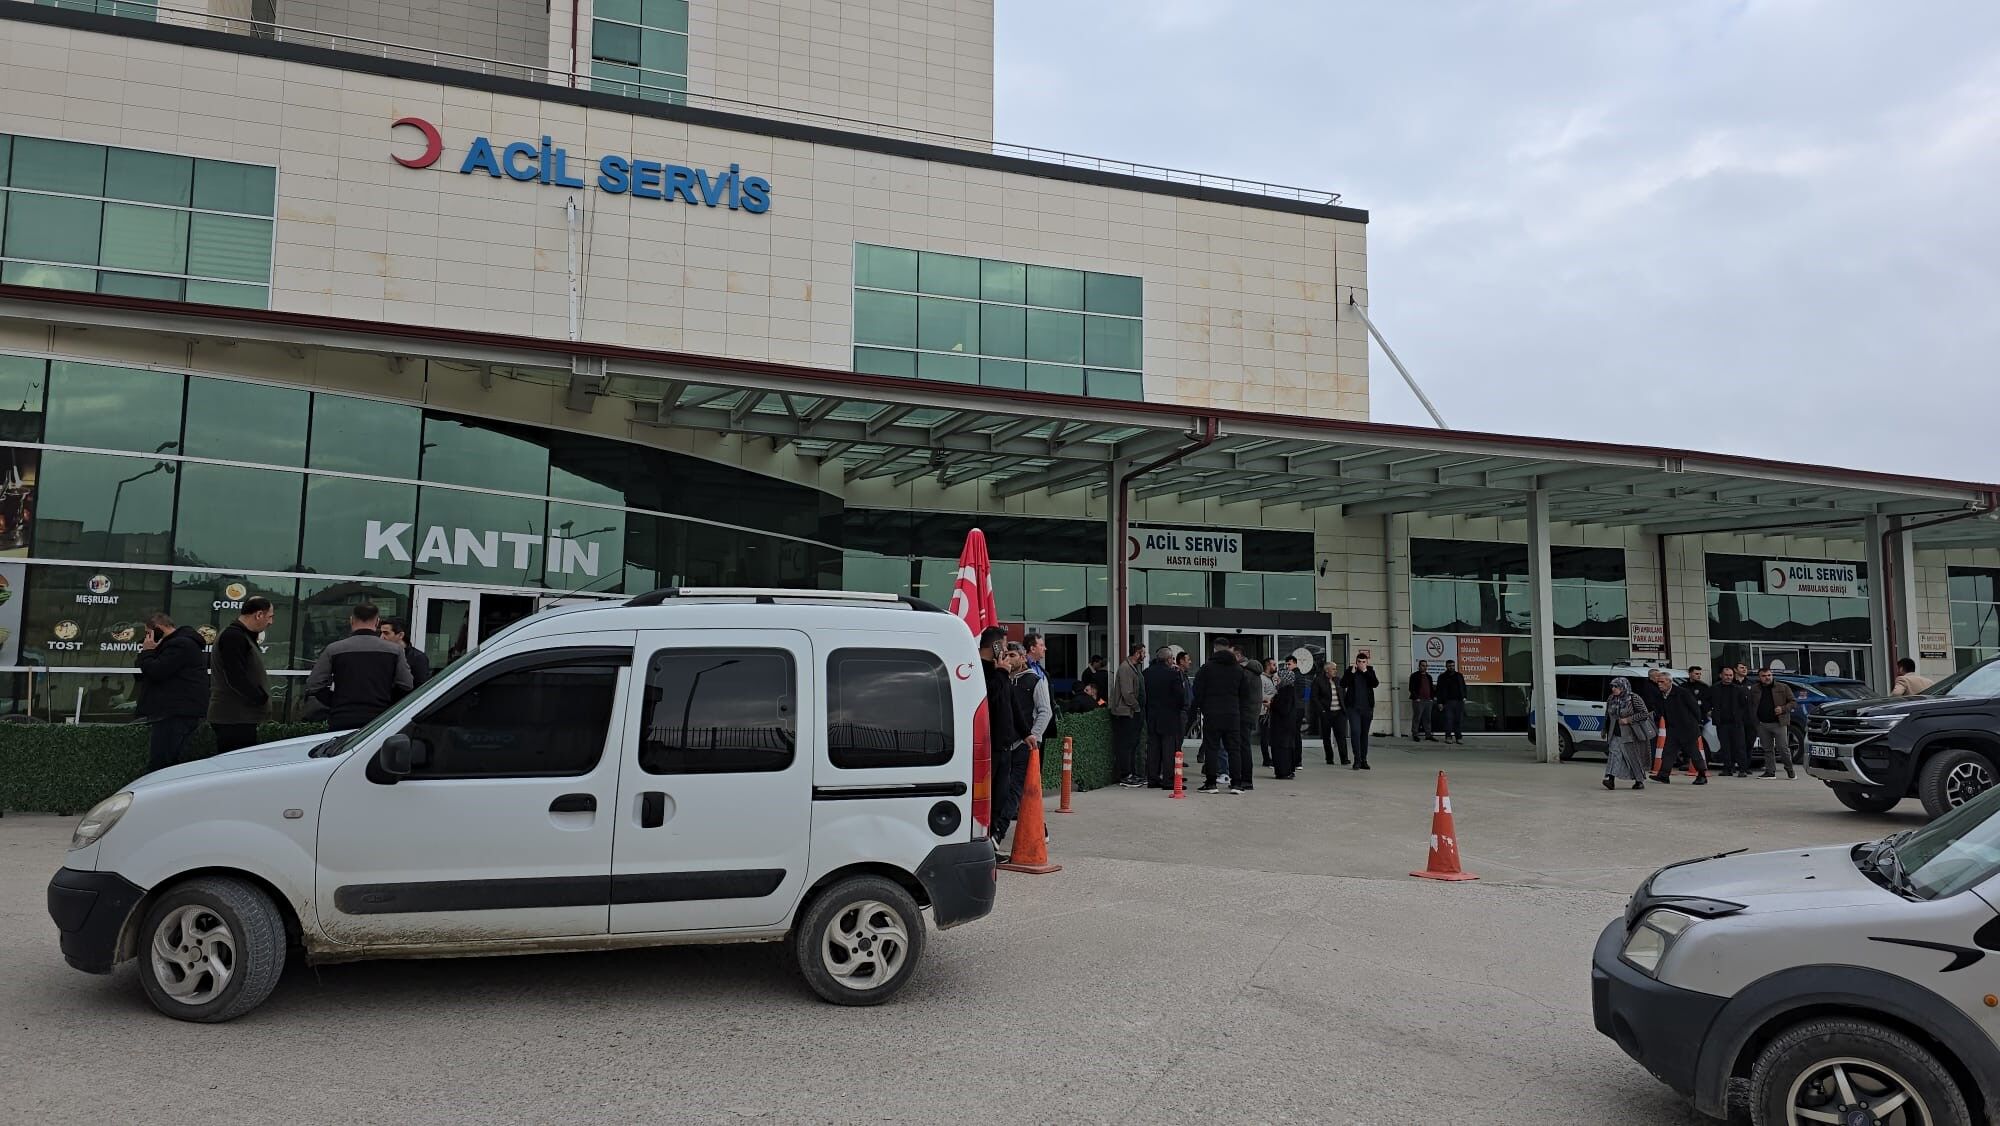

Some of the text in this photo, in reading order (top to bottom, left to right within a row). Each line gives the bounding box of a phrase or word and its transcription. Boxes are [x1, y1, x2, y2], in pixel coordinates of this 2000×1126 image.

[459, 135, 771, 214] ACİL SERVİS
[363, 519, 600, 577] KANTİN
[1145, 532, 1237, 553] ACİL SERVİS
[1166, 556, 1217, 568] HASTA GİRİŞİ
[1789, 564, 1854, 581] ACİL SERVİS
[1798, 584, 1828, 593] AMBULANS
[75, 594, 119, 605] MEŞRUBAT
[212, 600, 245, 611] ÇOR
[47, 641, 144, 653] TOST SANDVİÇ
